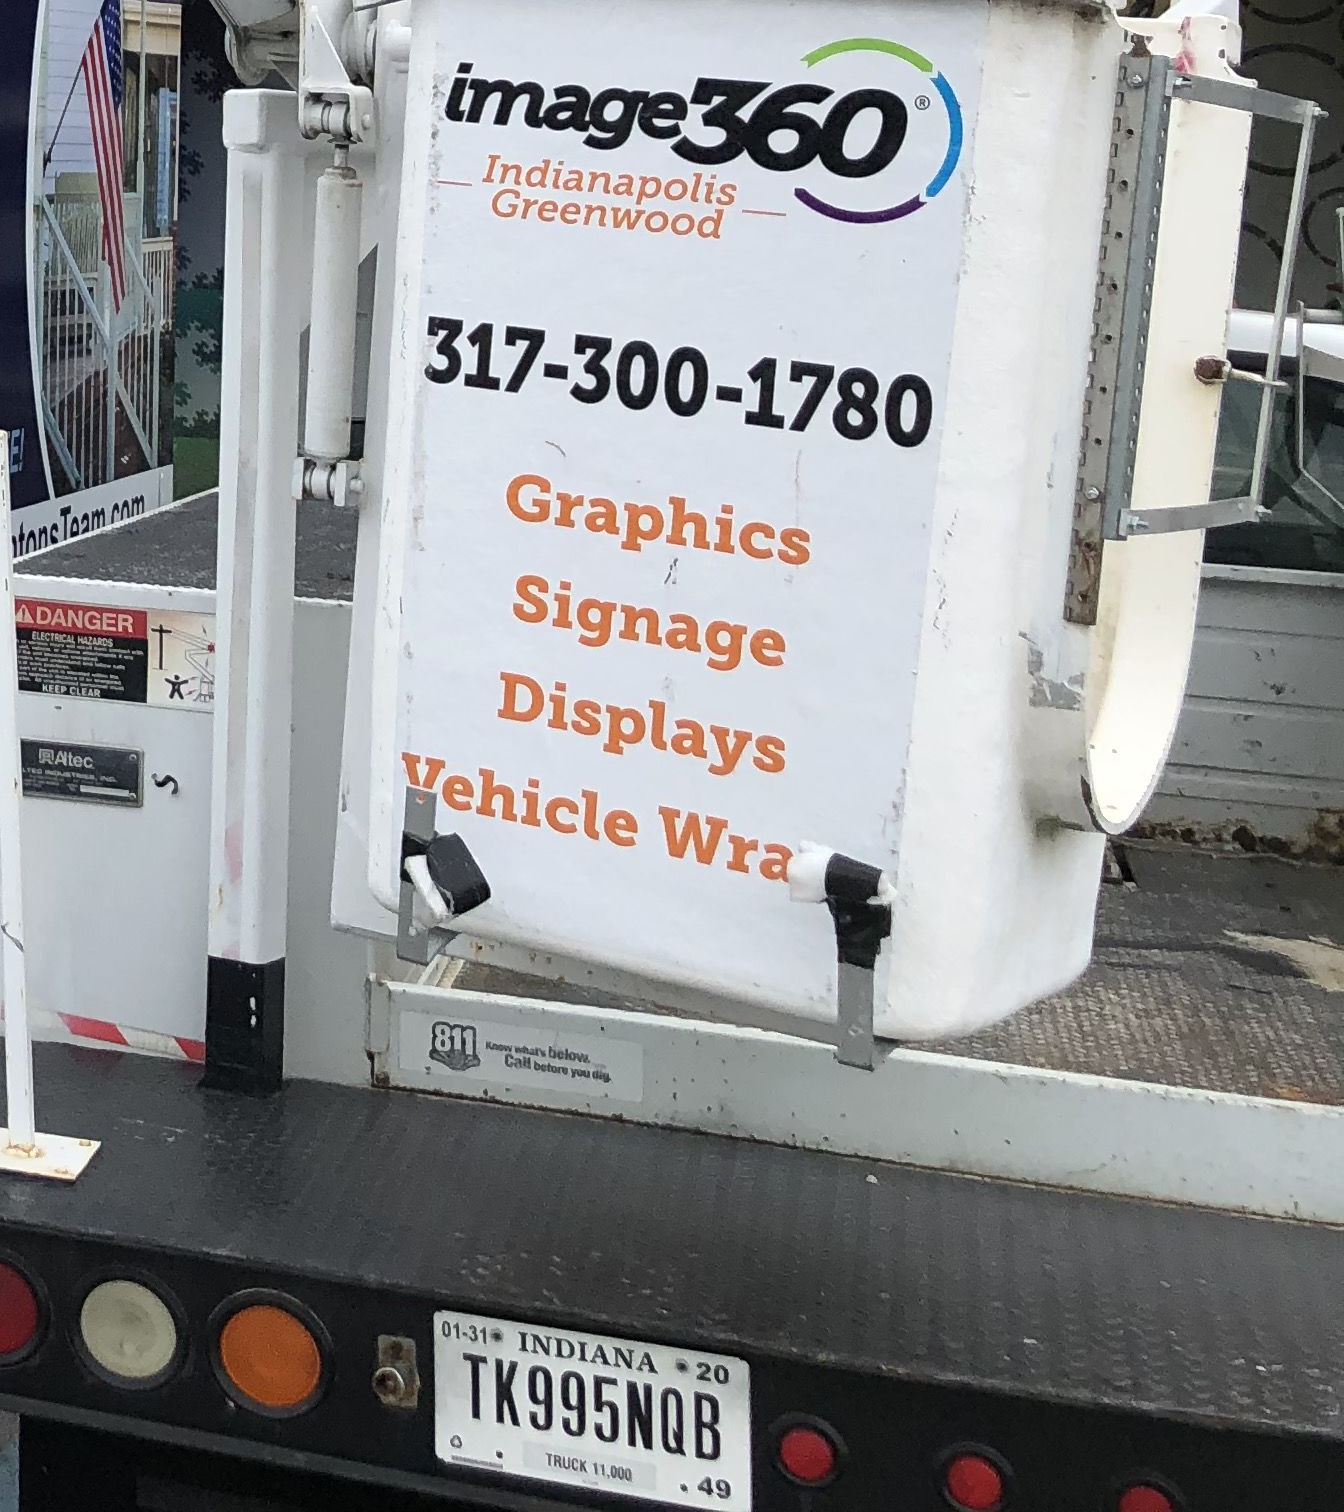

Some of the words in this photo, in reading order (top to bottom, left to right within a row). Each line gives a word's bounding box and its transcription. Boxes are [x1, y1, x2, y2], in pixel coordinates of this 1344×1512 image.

[445, 62, 908, 178] image360
[481, 154, 737, 206] Indianapolis
[491, 188, 725, 239] Greenwood
[424, 315, 933, 448] 317-300-1780
[505, 474, 812, 566] Graphics
[32, 631, 75, 647] ELECTRICAL
[35, 606, 134, 633] DANGER
[512, 574, 787, 672] Signage
[41, 684, 68, 694] KEEP
[69, 686, 101, 698] CLEAR
[497, 670, 788, 776] Displays
[54, 750, 95, 769] Altec
[402, 752, 639, 847] Vehicle
[658, 805, 793, 883] Wra
[432, 1021, 477, 1055] 811
[486, 1040, 513, 1054] Know
[548, 1046, 590, 1064] below.
[504, 1053, 531, 1070] Call
[533, 1062, 569, 1076] before
[570, 1068, 590, 1080] you
[441, 1320, 488, 1345] 01-31
[518, 1331, 658, 1375] INDIANA
[696, 1361, 730, 1385] 20
[462, 1352, 721, 1461] TK995NQB
[545, 1452, 588, 1474] TRUCK
[592, 1462, 633, 1483] 11,000
[697, 1476, 732, 1500] 49
